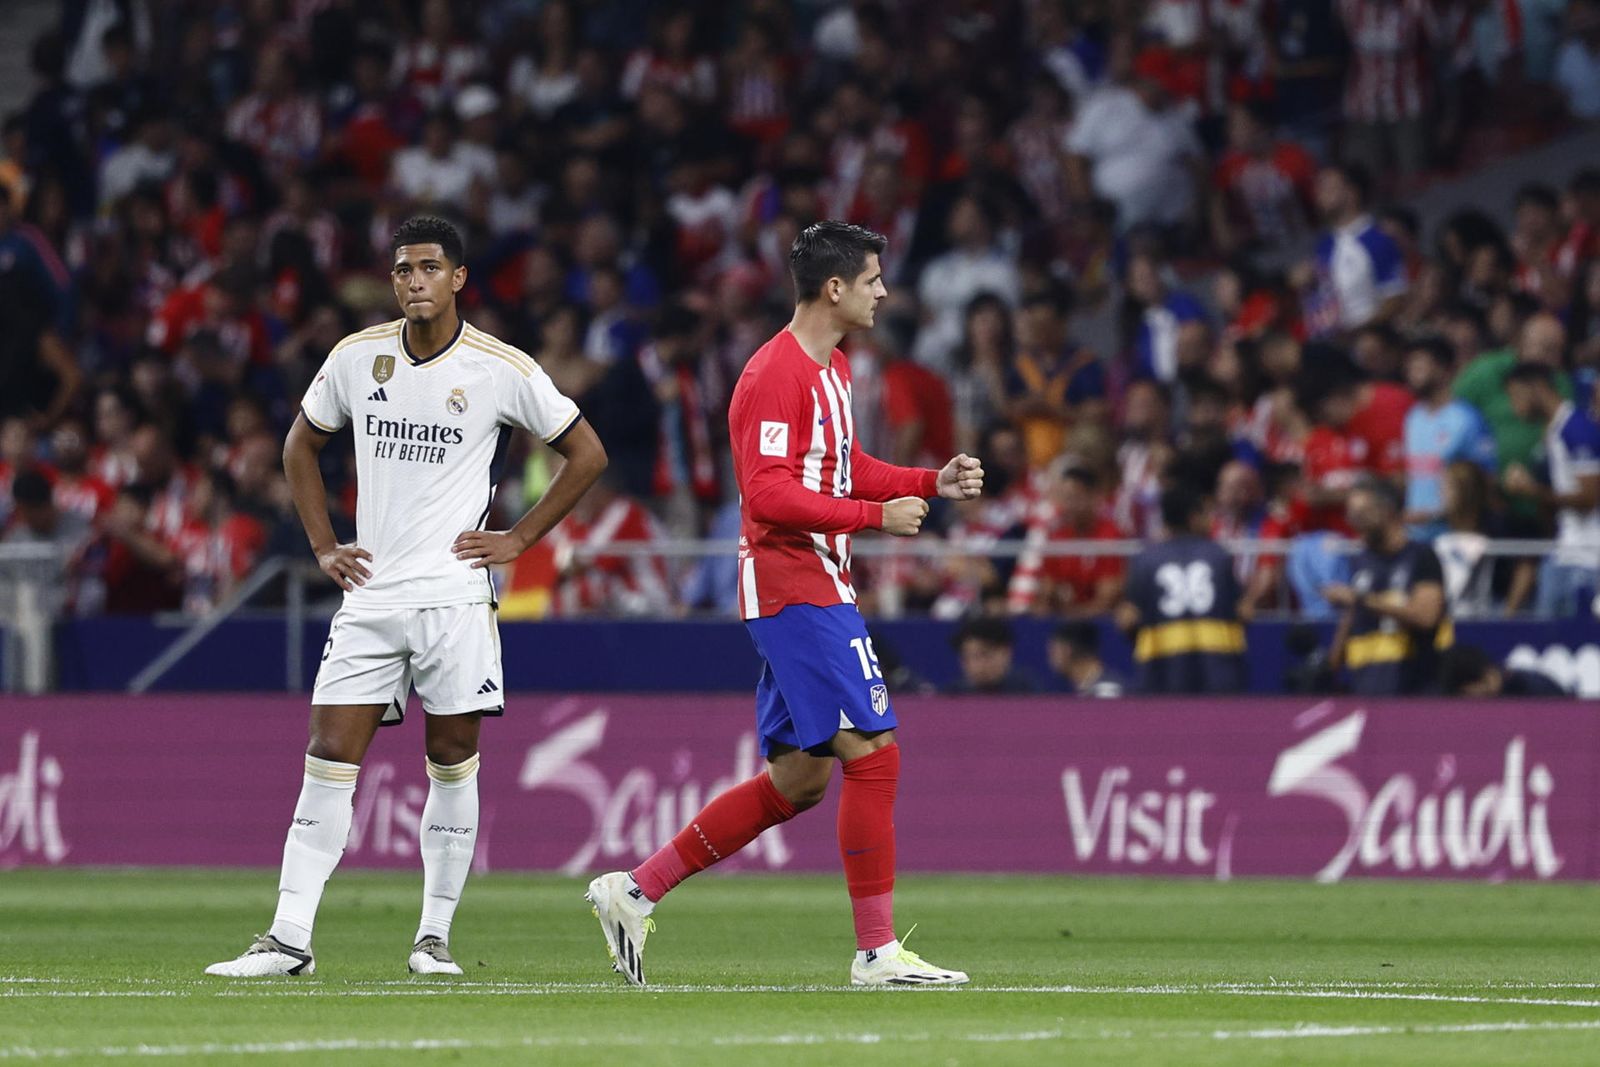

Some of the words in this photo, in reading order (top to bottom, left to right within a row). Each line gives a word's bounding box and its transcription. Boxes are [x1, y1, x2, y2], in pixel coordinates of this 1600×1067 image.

[366, 414, 464, 445] Emirates
[375, 441, 396, 459] FLY
[398, 443, 446, 464] BETTER
[1061, 766, 1216, 864] Visit
[1266, 708, 1564, 883] Saudi
[293, 818, 320, 827] MCF
[428, 824, 473, 835] RMCF
